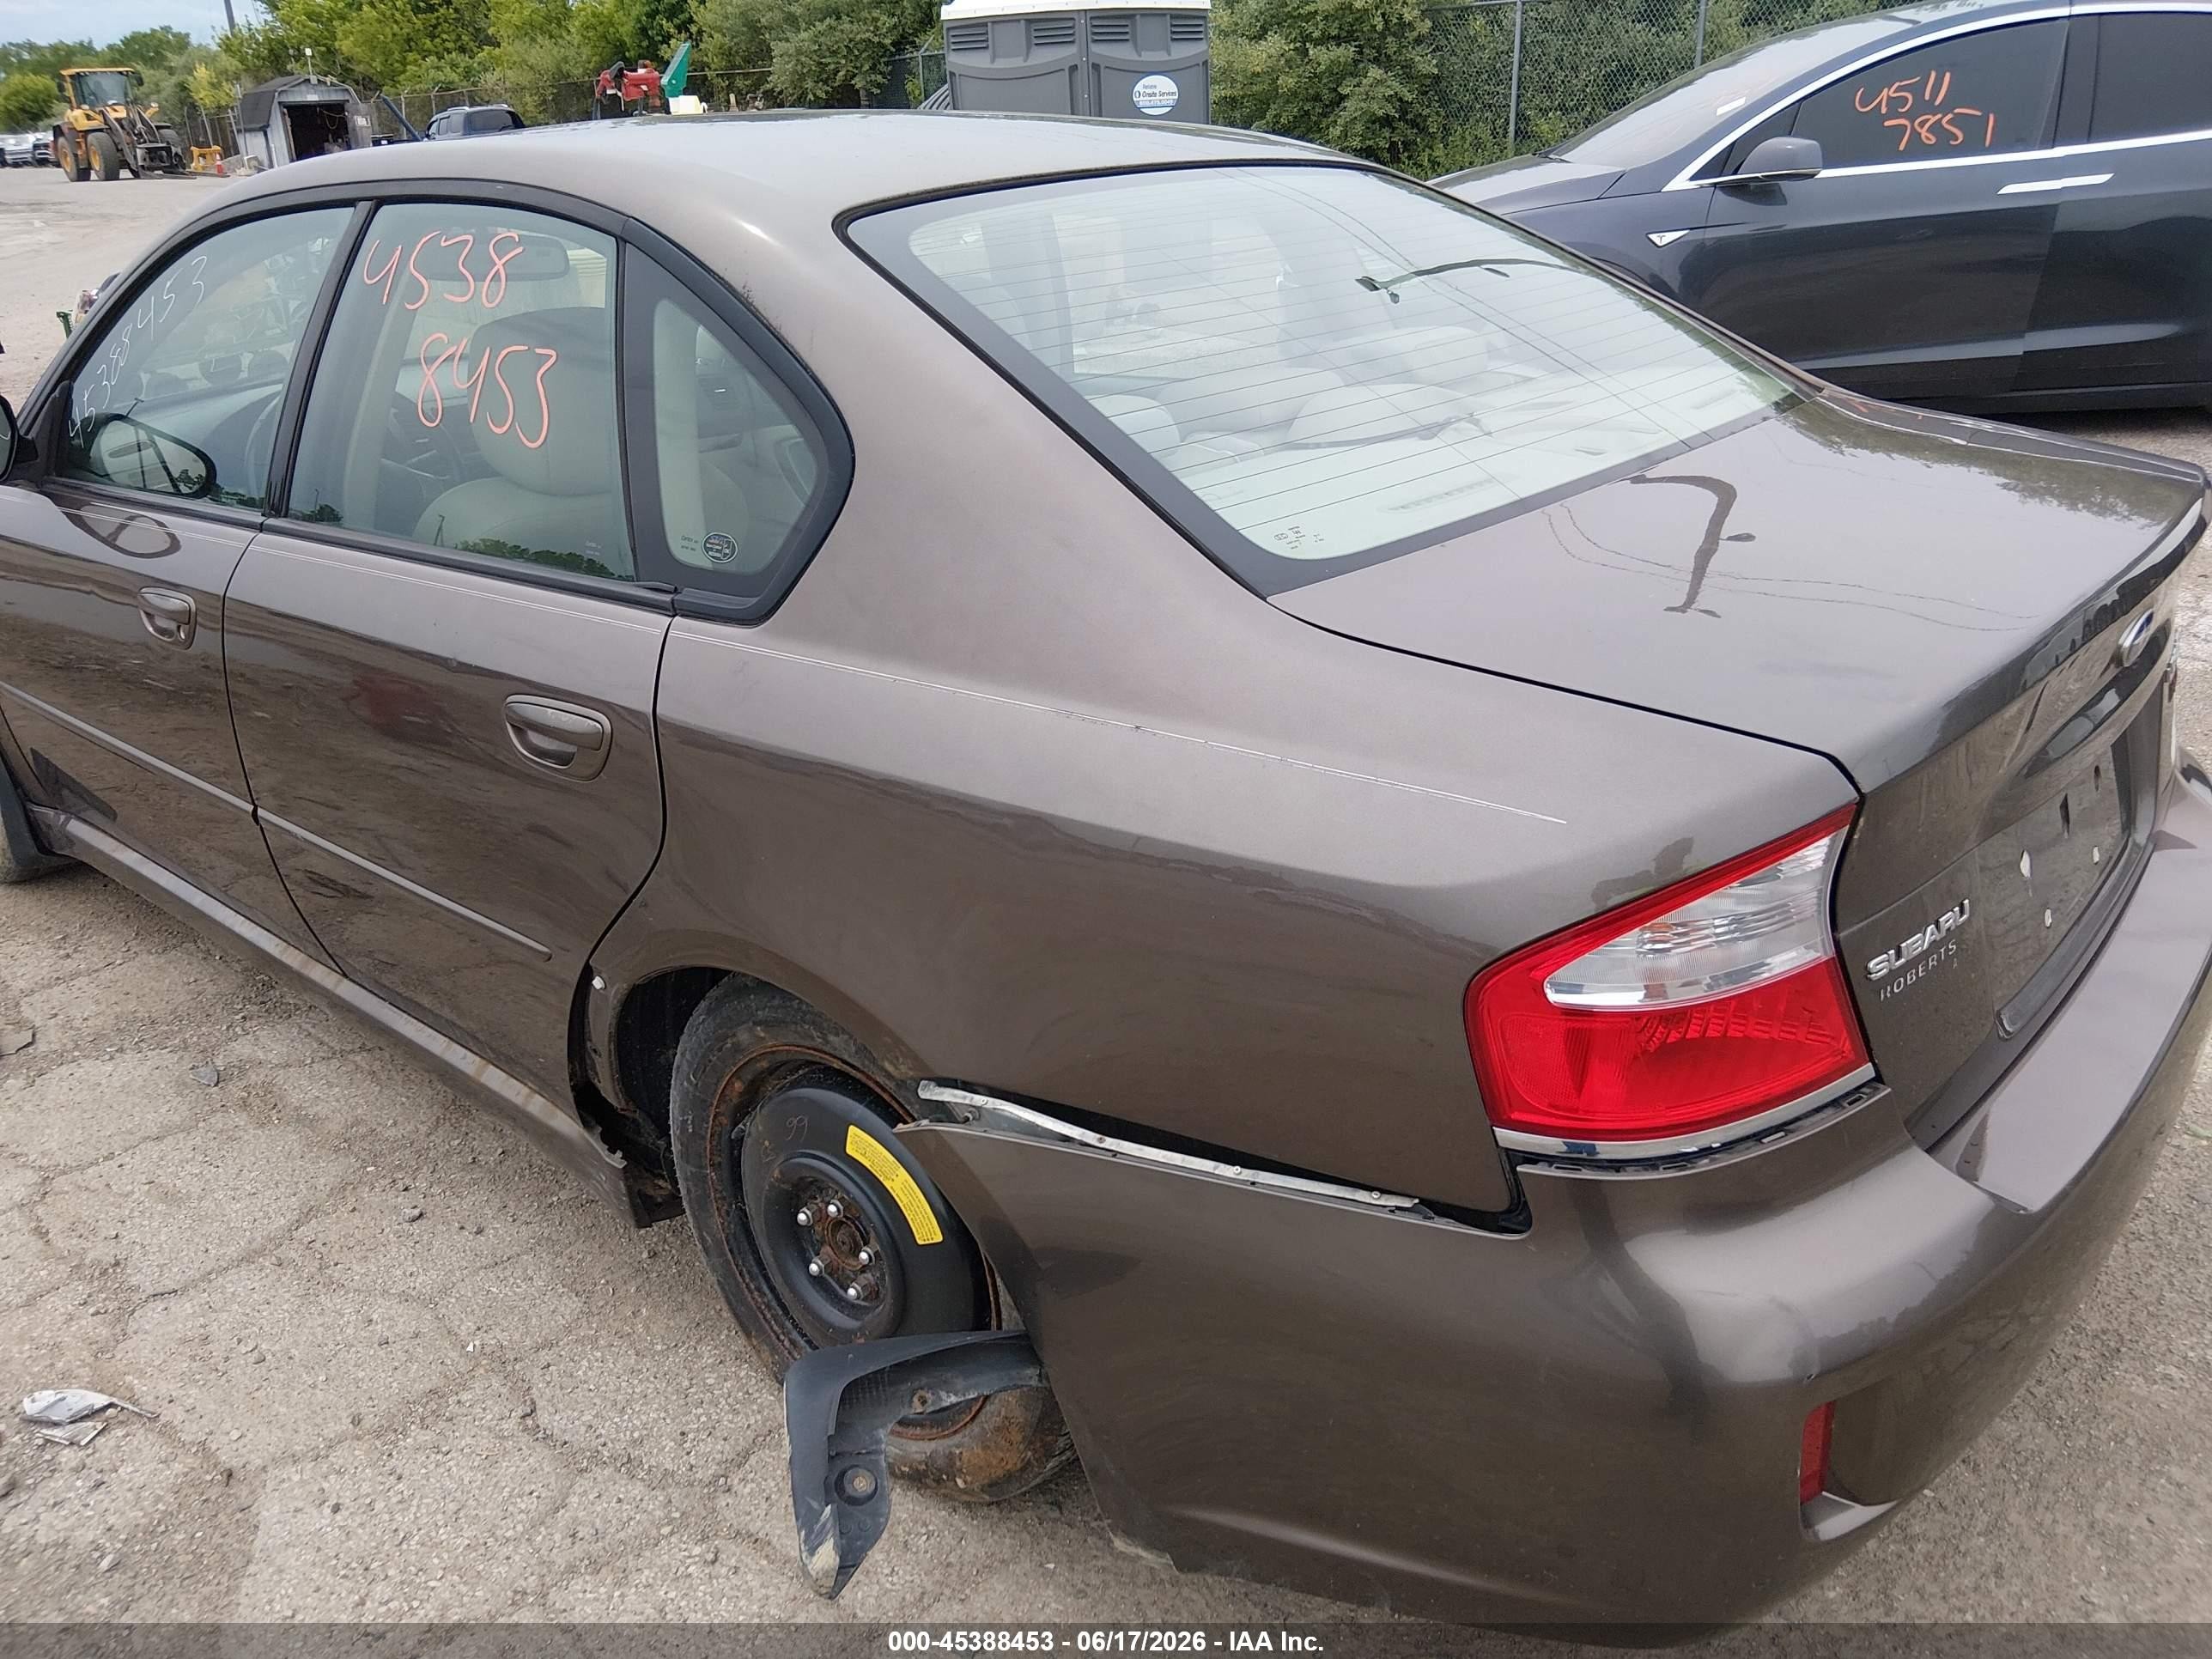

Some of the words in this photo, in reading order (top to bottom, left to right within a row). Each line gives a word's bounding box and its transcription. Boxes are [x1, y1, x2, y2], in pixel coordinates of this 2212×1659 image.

[1854, 70, 1951, 114] 4511
[1883, 107, 1996, 151] 7851
[363, 230, 526, 310] 4538
[417, 332, 557, 448] 8453
[1867, 898, 1970, 981] SUBARU
